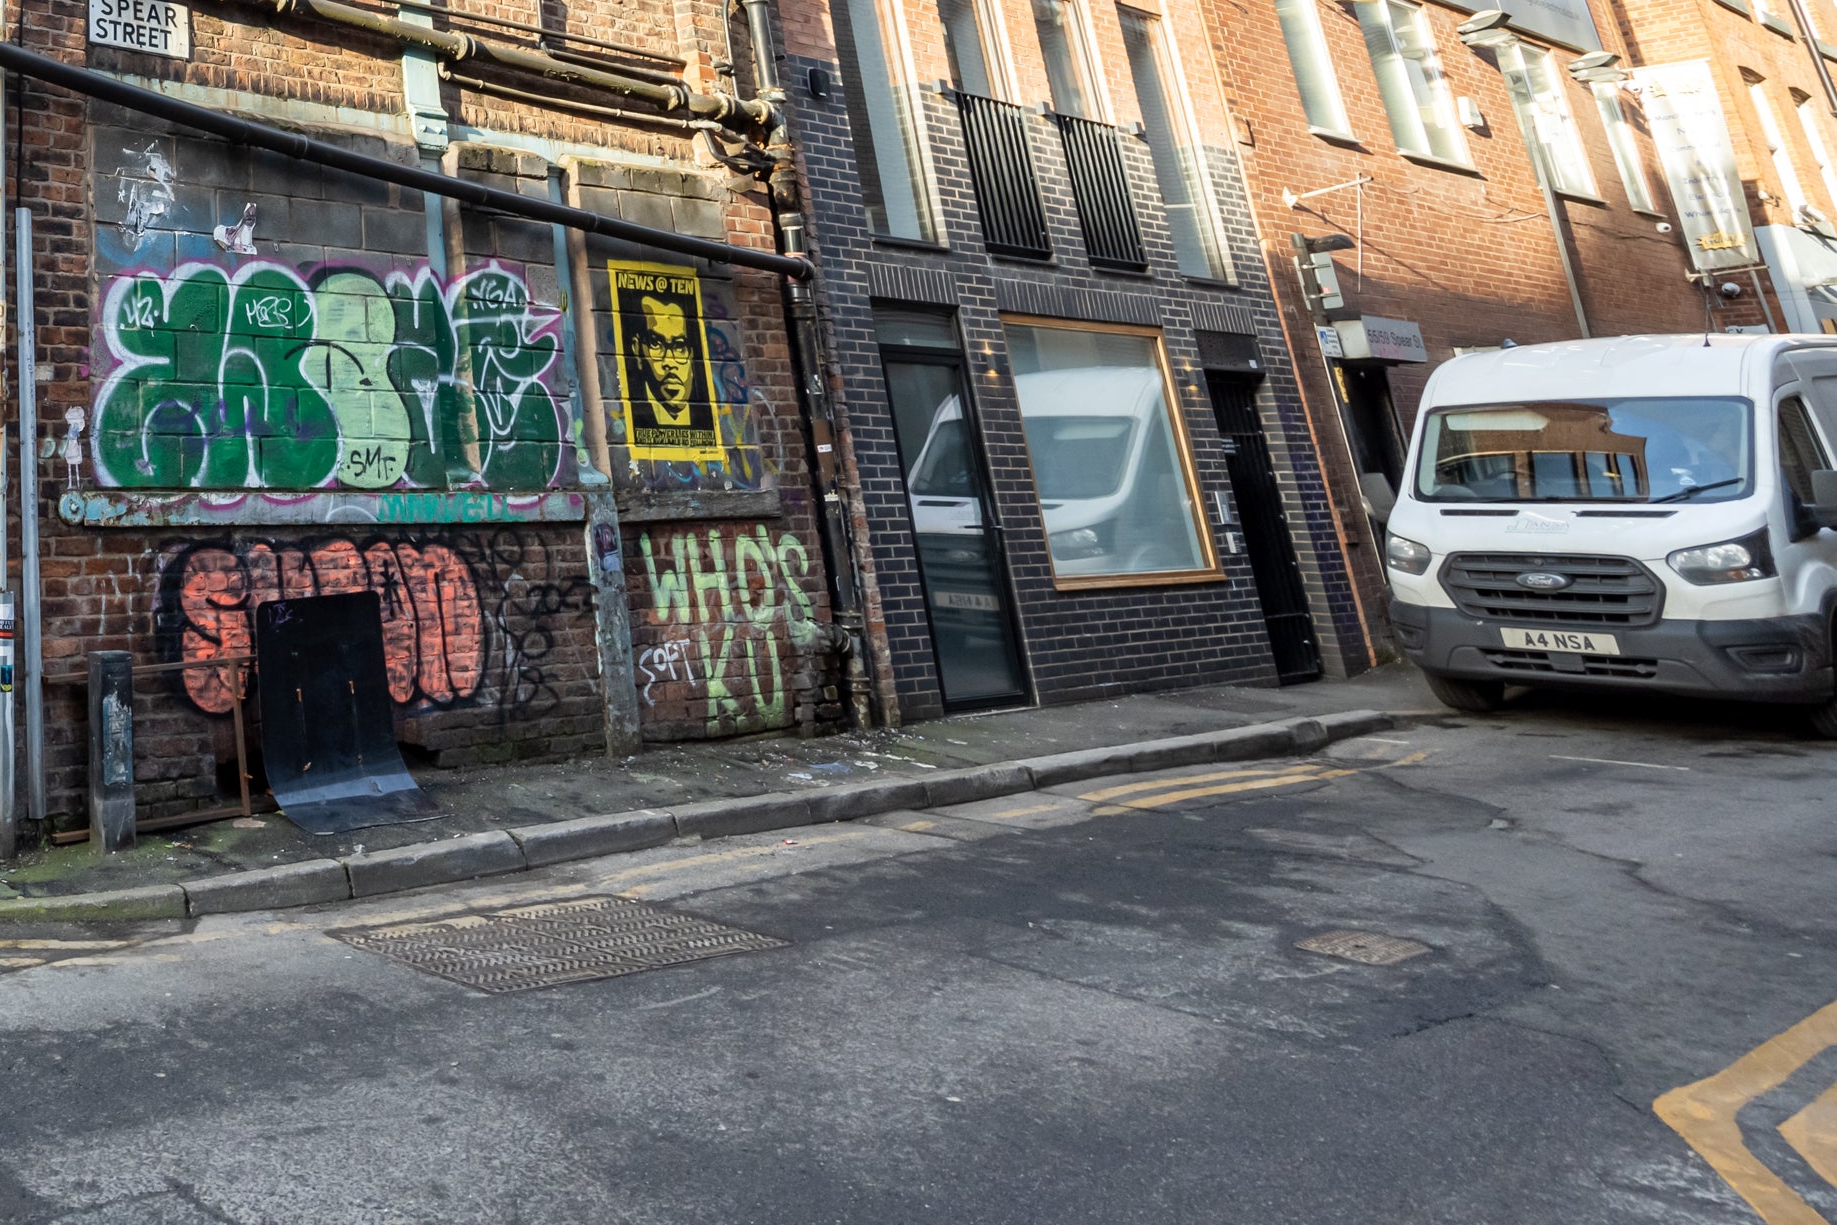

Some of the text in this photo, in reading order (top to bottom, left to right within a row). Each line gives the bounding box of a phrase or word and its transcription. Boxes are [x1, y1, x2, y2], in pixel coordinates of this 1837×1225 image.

[95, 17, 172, 50] STREET
[618, 272, 695, 295] NEWS @ TEN
[639, 524, 818, 642] WHO'S
[1526, 575, 1553, 585] Ford
[1524, 631, 1596, 651] A4 NSA
[639, 638, 697, 707] SOFT
